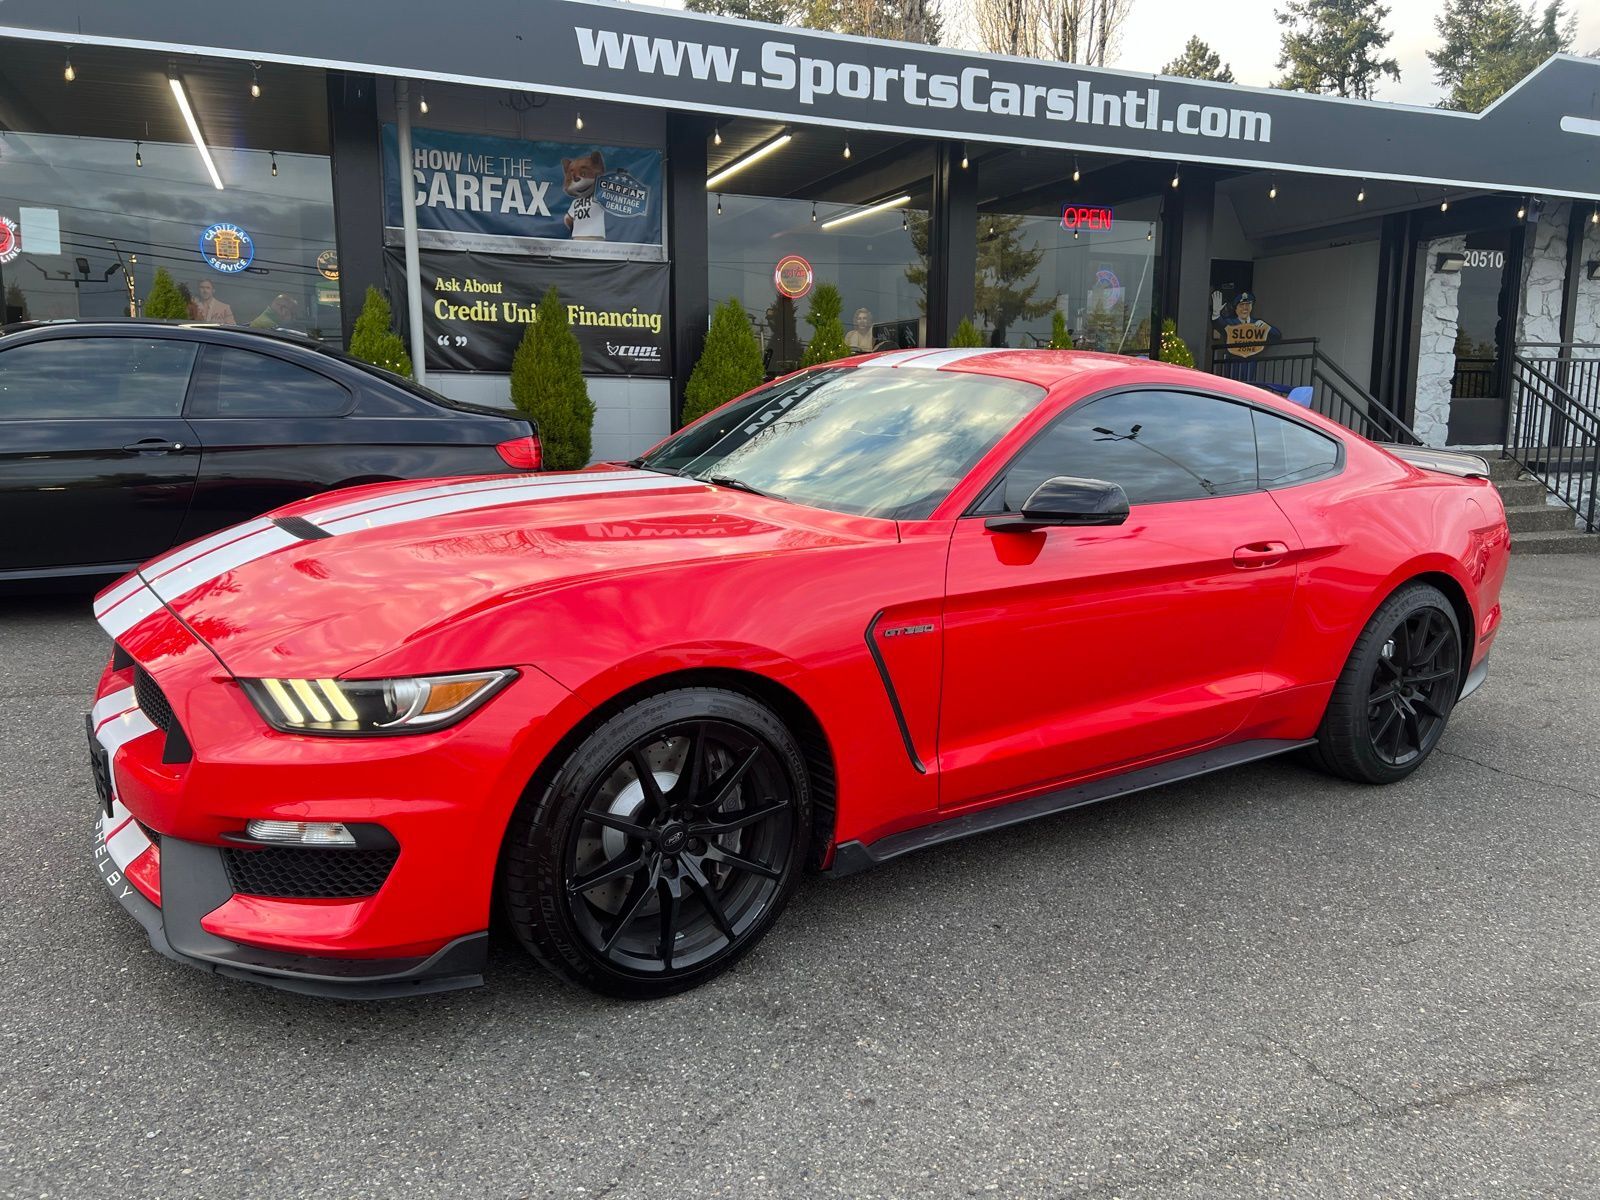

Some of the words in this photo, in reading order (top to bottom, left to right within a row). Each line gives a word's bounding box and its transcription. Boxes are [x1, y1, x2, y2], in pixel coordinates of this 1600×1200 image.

[574, 27, 1272, 143] www.SportsCarsIntl.com
[412, 148, 461, 171] HOW
[467, 153, 495, 175] ME
[499, 157, 532, 179] THE
[600, 181, 645, 200] CARFAX
[573, 197, 592, 208] CAR
[601, 191, 641, 208] ADVANTAGE
[605, 201, 632, 214] DEALER
[573, 208, 591, 220] FOX
[1064, 207, 1112, 230] OPEN
[204, 224, 250, 244] CADILLAC
[209, 257, 247, 271] SERVICE
[1464, 251, 1504, 268] 20510
[435, 278, 460, 292] Ask
[464, 279, 502, 294] About
[434, 299, 498, 322] Credit
[503, 302, 541, 324] Uni
[567, 305, 662, 334] Financing
[1232, 328, 1265, 340] SLOW
[618, 345, 661, 357] CUDL
[94, 820, 133, 899] SHELBY
